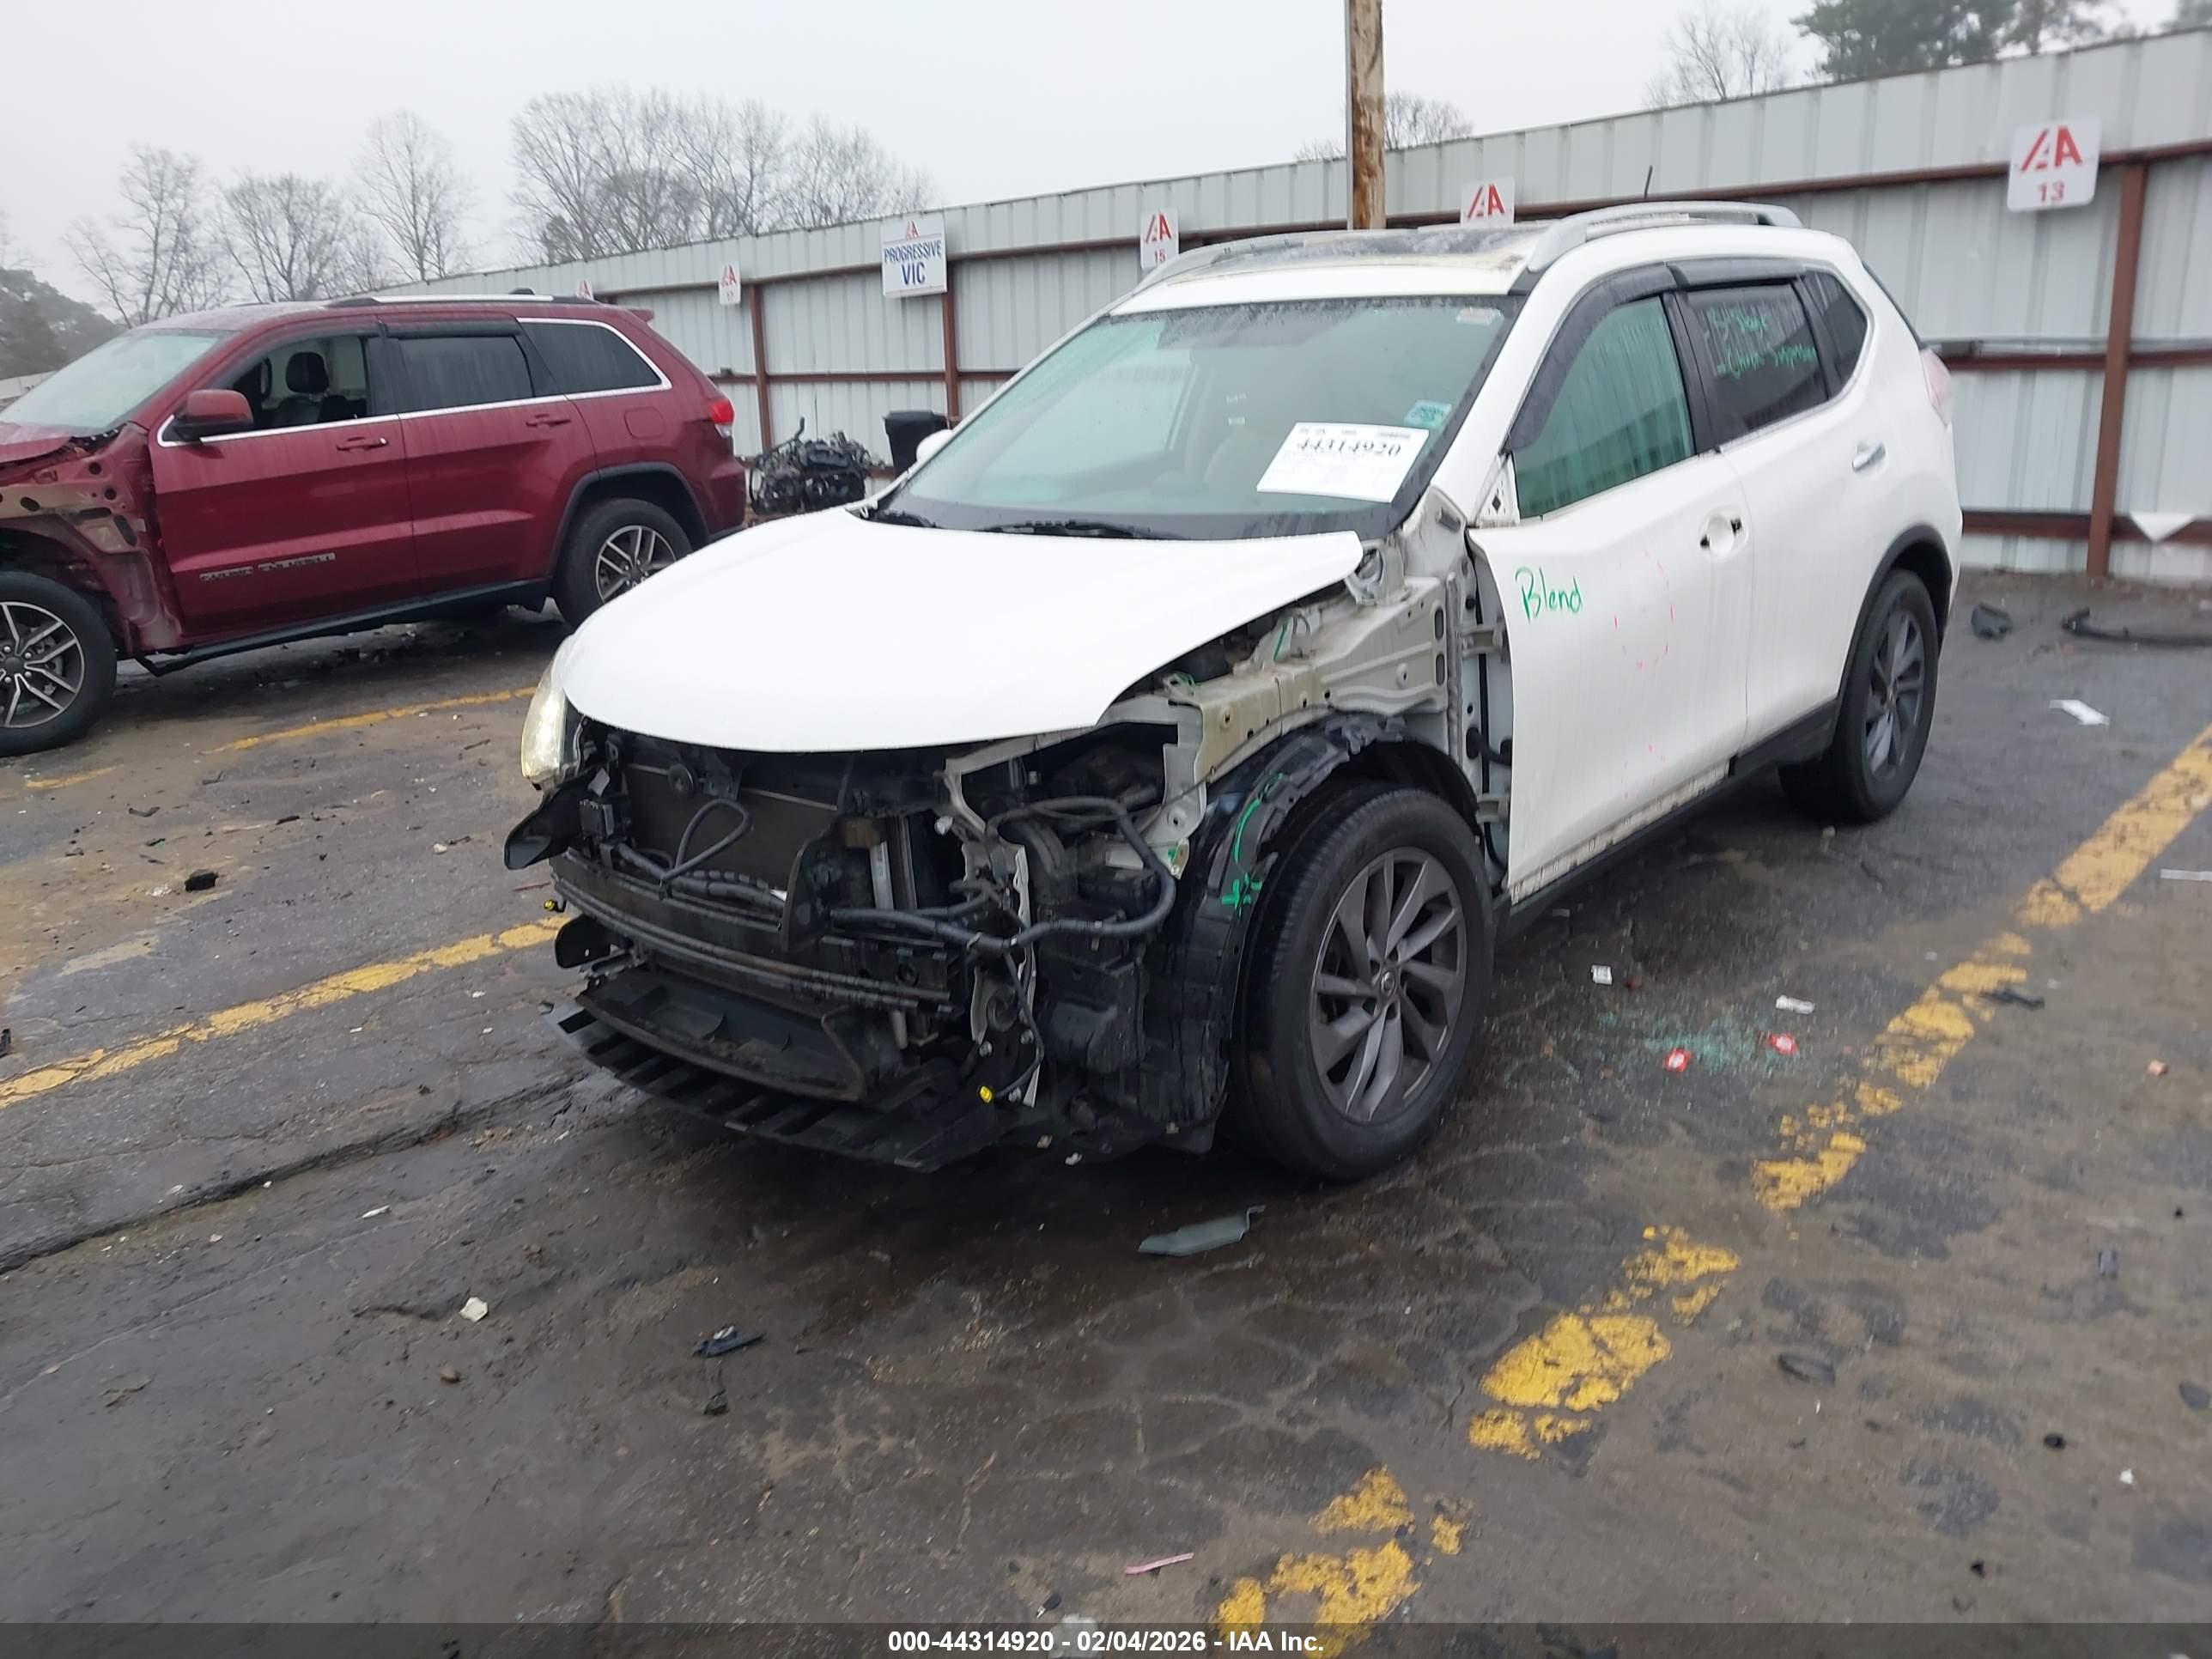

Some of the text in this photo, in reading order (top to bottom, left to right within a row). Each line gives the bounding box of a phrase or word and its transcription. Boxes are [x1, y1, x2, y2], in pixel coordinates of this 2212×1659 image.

[2037, 180, 2065, 203] 13
[884, 240, 942, 264] PROGRESSIVE
[902, 261, 926, 285] VIC
[1297, 438, 1401, 456] 44314920
[1515, 566, 1583, 625] Blend
